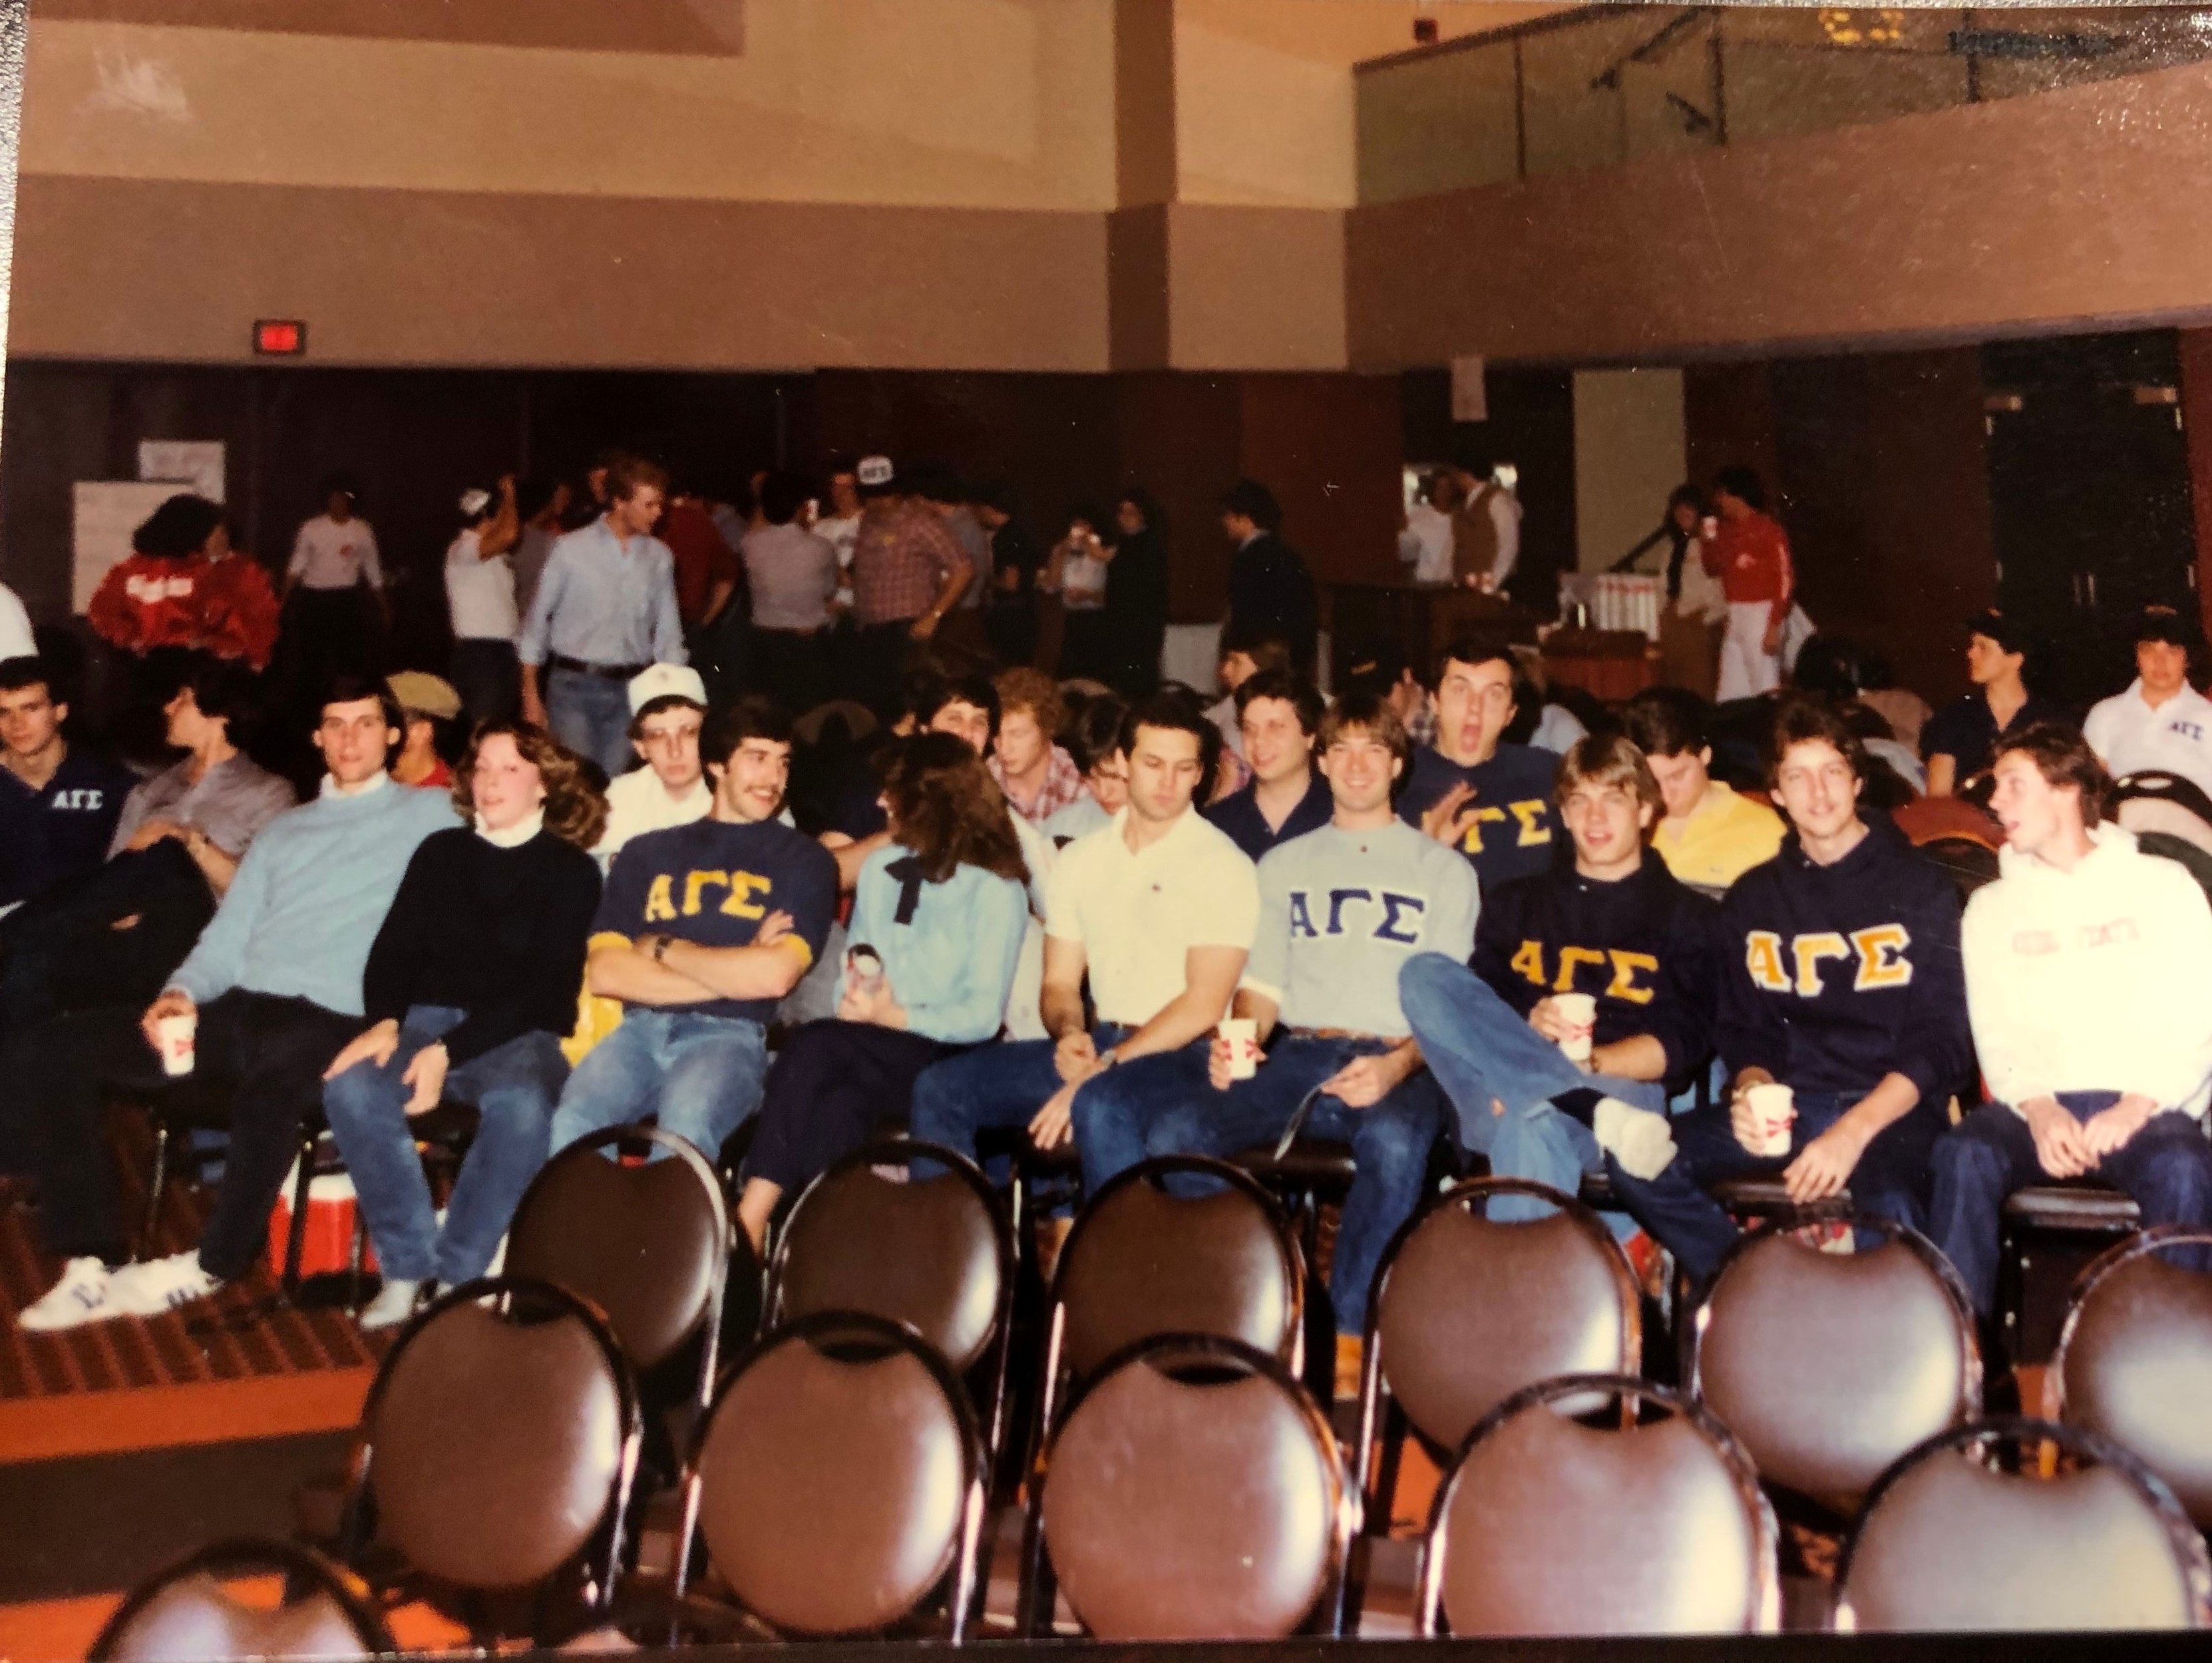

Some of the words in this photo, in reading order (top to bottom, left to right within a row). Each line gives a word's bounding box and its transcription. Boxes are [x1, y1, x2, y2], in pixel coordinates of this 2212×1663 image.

[1422, 799, 1551, 854] ΓΣ
[645, 870, 772, 922] ΑΓΣ
[1290, 888, 1424, 944] ΑΓΣ
[1746, 923, 1913, 998] ΑΓΣ
